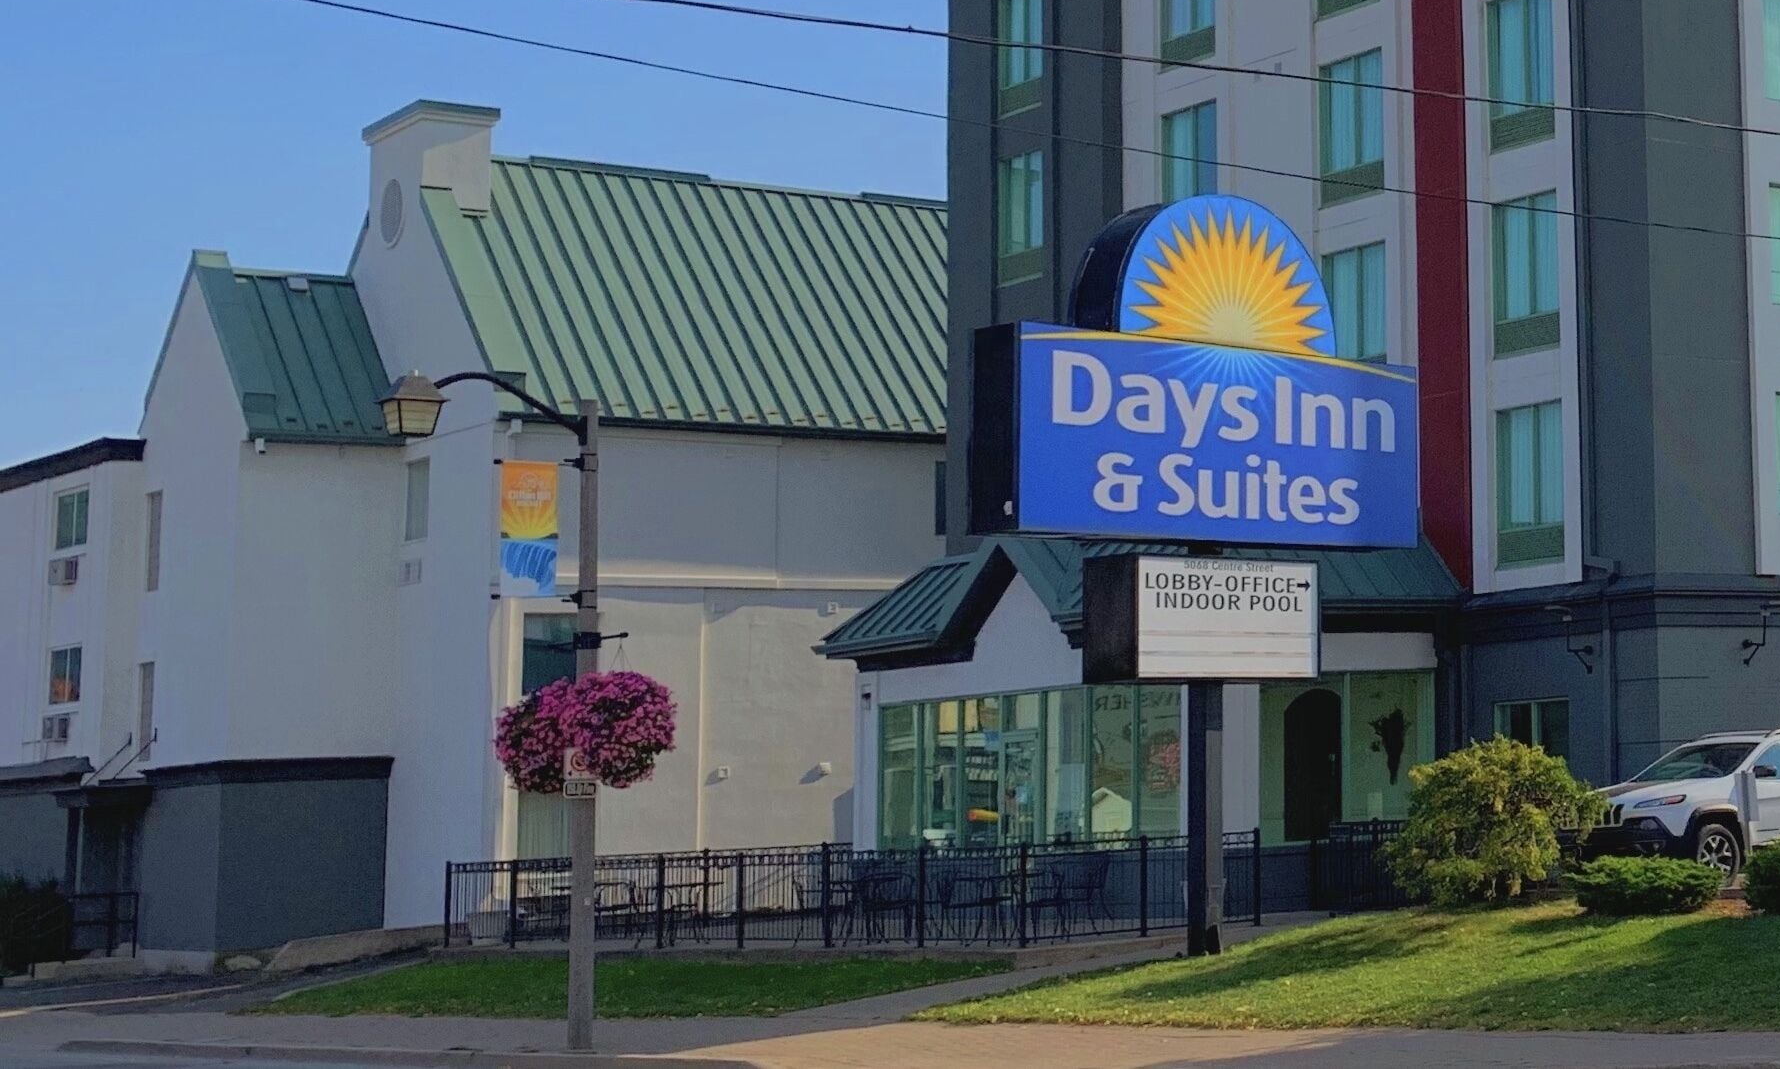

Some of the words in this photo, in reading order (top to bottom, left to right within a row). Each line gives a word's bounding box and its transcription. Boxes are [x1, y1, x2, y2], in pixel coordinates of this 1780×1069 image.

[1051, 349, 1260, 449] Days
[1274, 376, 1396, 453] Inn
[1092, 452, 1143, 513] &
[1157, 453, 1361, 525] Suites
[1211, 561, 1243, 572] Centre
[1246, 562, 1274, 573] Street
[1145, 572, 1296, 594] LOBBY-OFFICE
[1155, 592, 1241, 611] INDOOR
[1249, 595, 1304, 612] POOL
